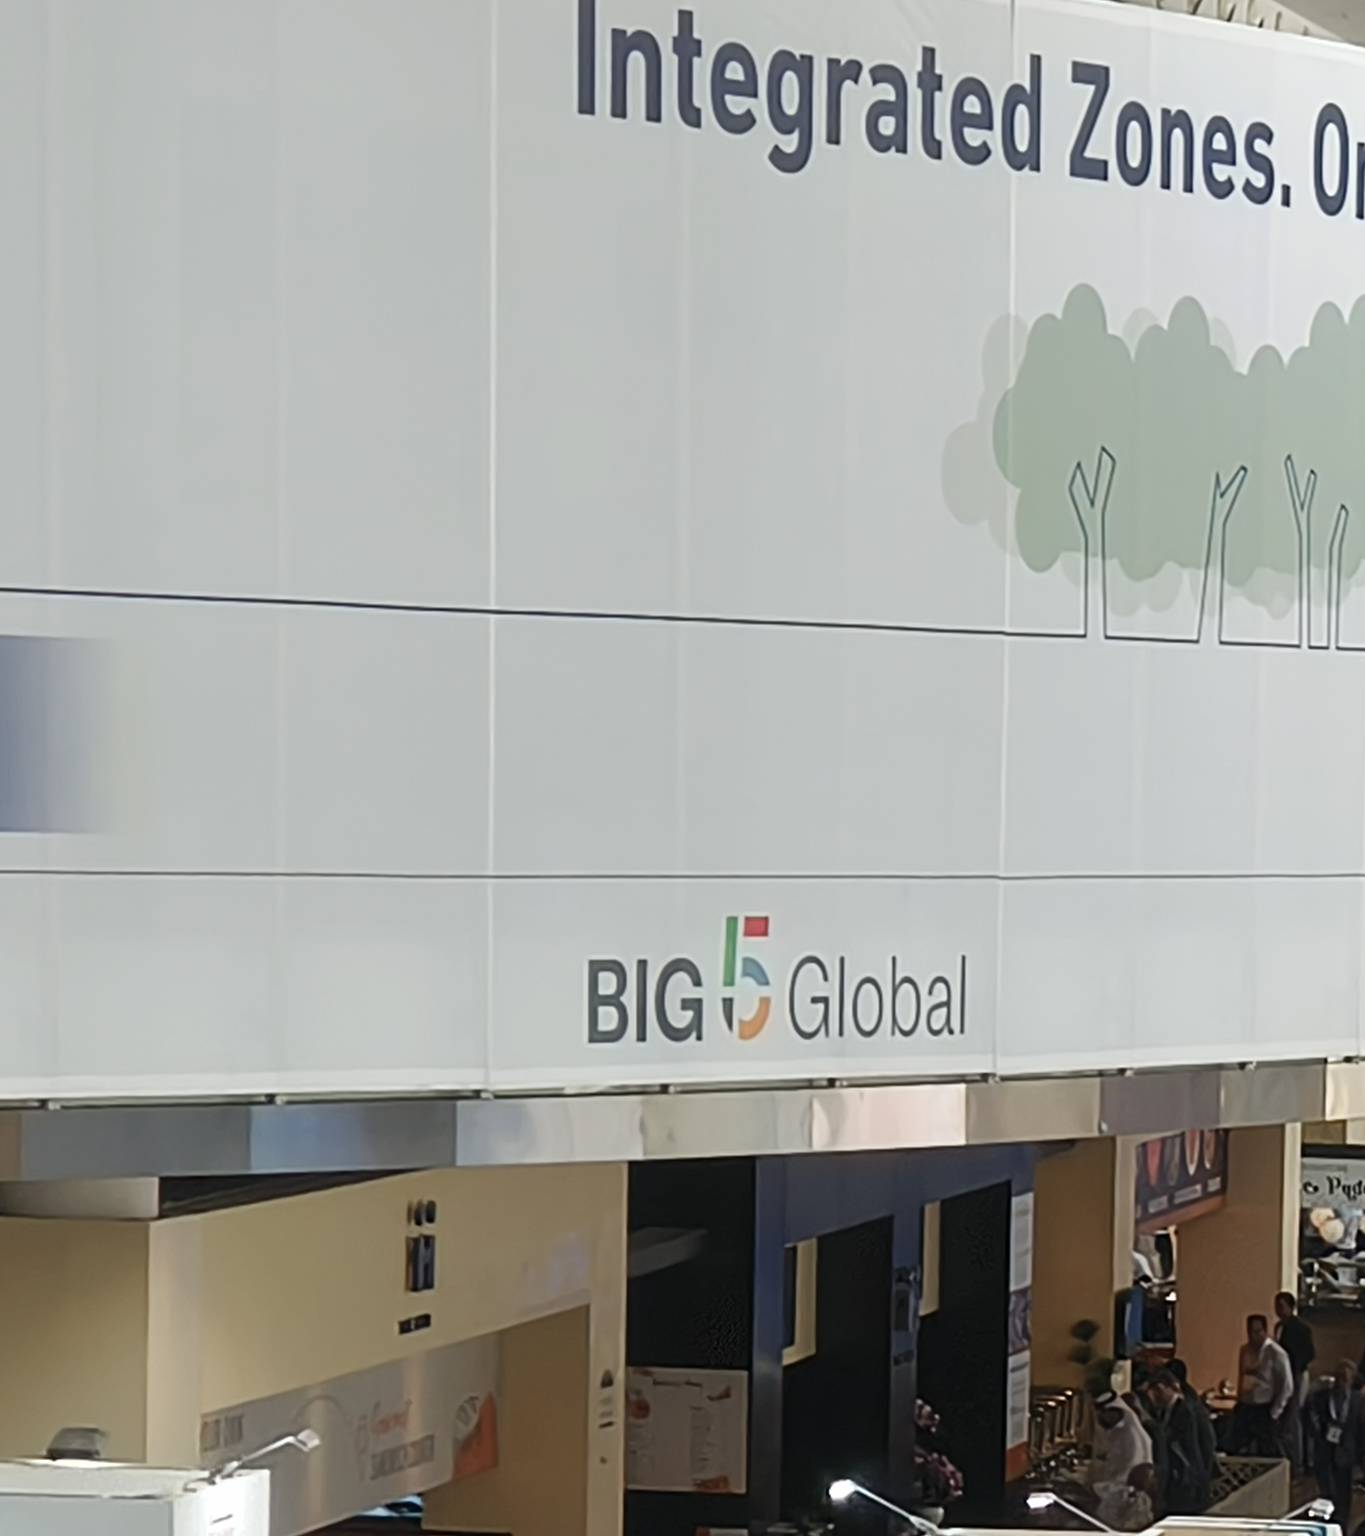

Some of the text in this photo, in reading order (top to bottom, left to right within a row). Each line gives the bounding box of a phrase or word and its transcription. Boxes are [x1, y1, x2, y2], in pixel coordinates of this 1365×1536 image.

[577, 0, 1042, 174] Integrated
[1070, 60, 1292, 208] Zones.
[588, 916, 968, 1044] BIG 5 Global
